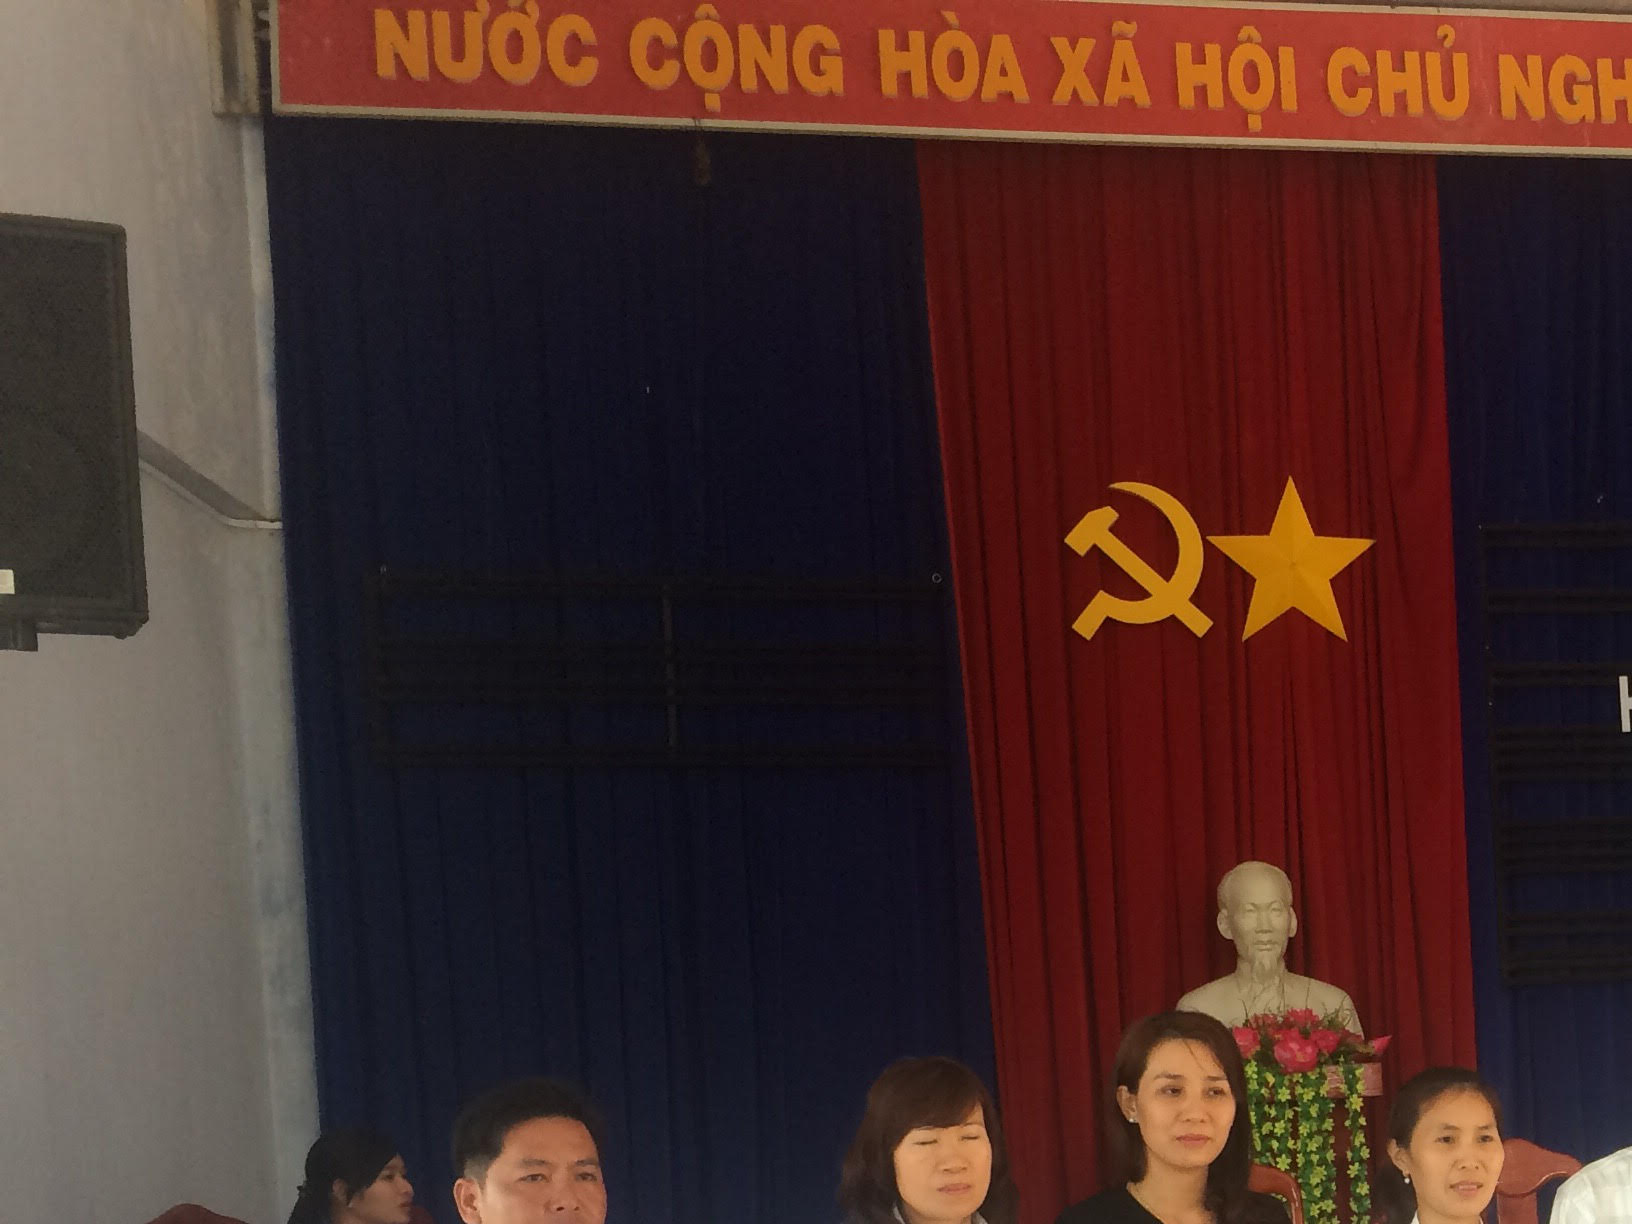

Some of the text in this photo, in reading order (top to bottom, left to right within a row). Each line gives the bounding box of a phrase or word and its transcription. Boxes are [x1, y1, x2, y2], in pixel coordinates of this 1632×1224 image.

[373, 0, 599, 86] NƯỚC
[628, 2, 846, 112] CỘNG
[877, 11, 1030, 103] HÒA
[1049, 19, 1153, 107] XÃ
[1174, 24, 1298, 132] HỘI
[1325, 24, 1471, 120] CHỦ
